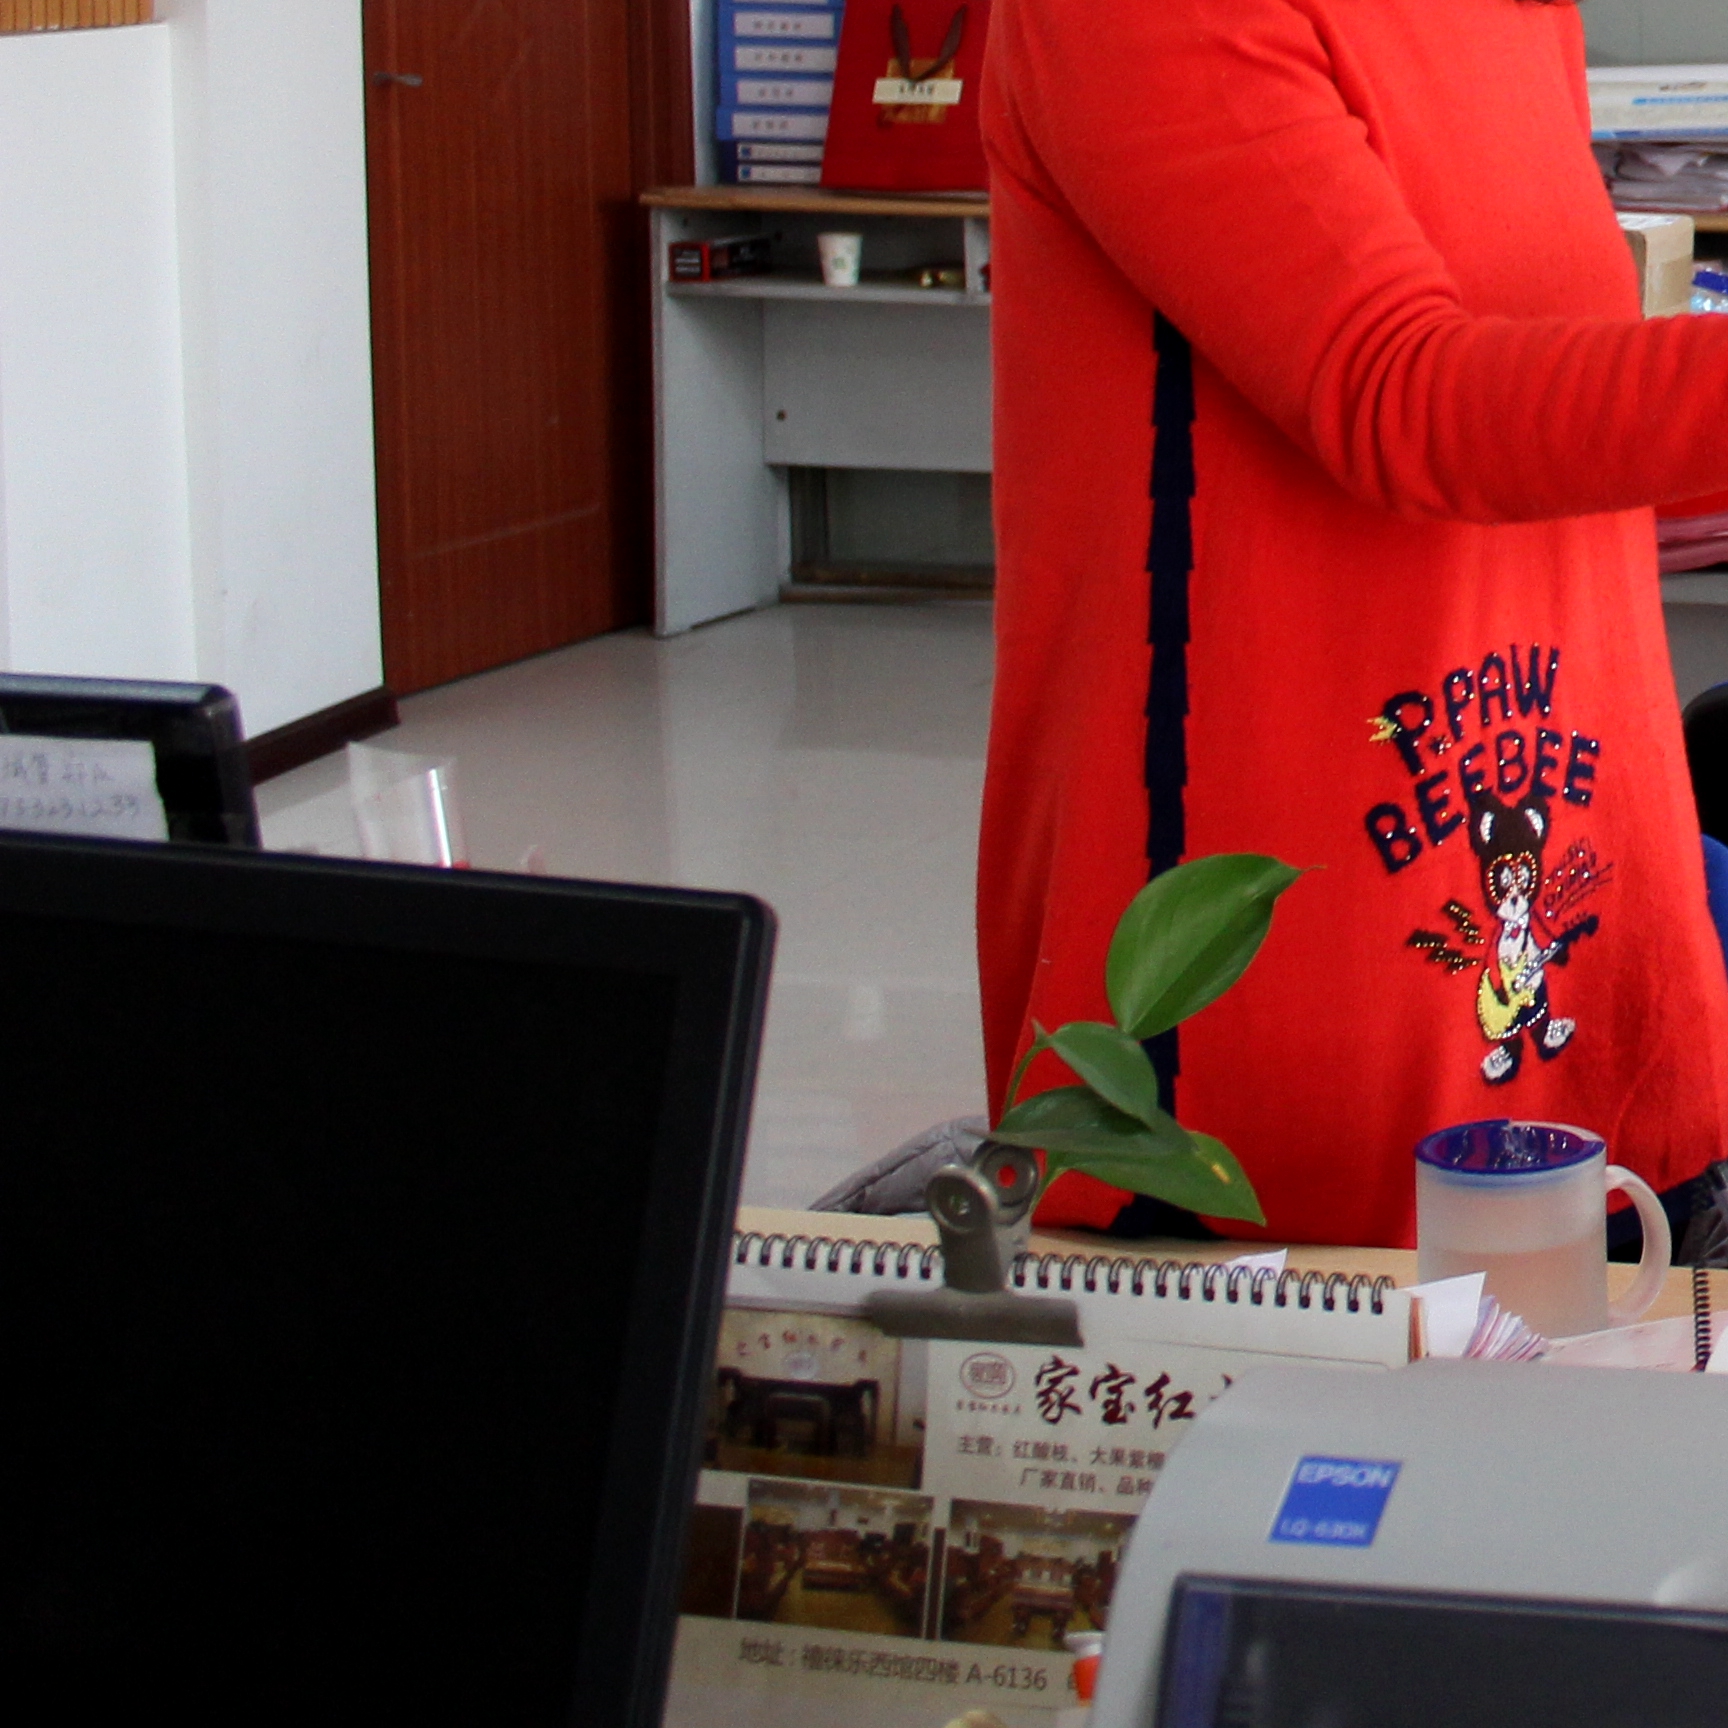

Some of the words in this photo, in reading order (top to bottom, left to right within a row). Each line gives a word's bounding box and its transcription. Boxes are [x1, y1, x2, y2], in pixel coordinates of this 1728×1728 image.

[1363, 725, 1601, 875] BEEBEE
[1034, 1354, 1236, 1430] 家宝红
[1297, 1463, 1393, 1489] EPSON
[964, 1662, 1048, 1692] A-6136
